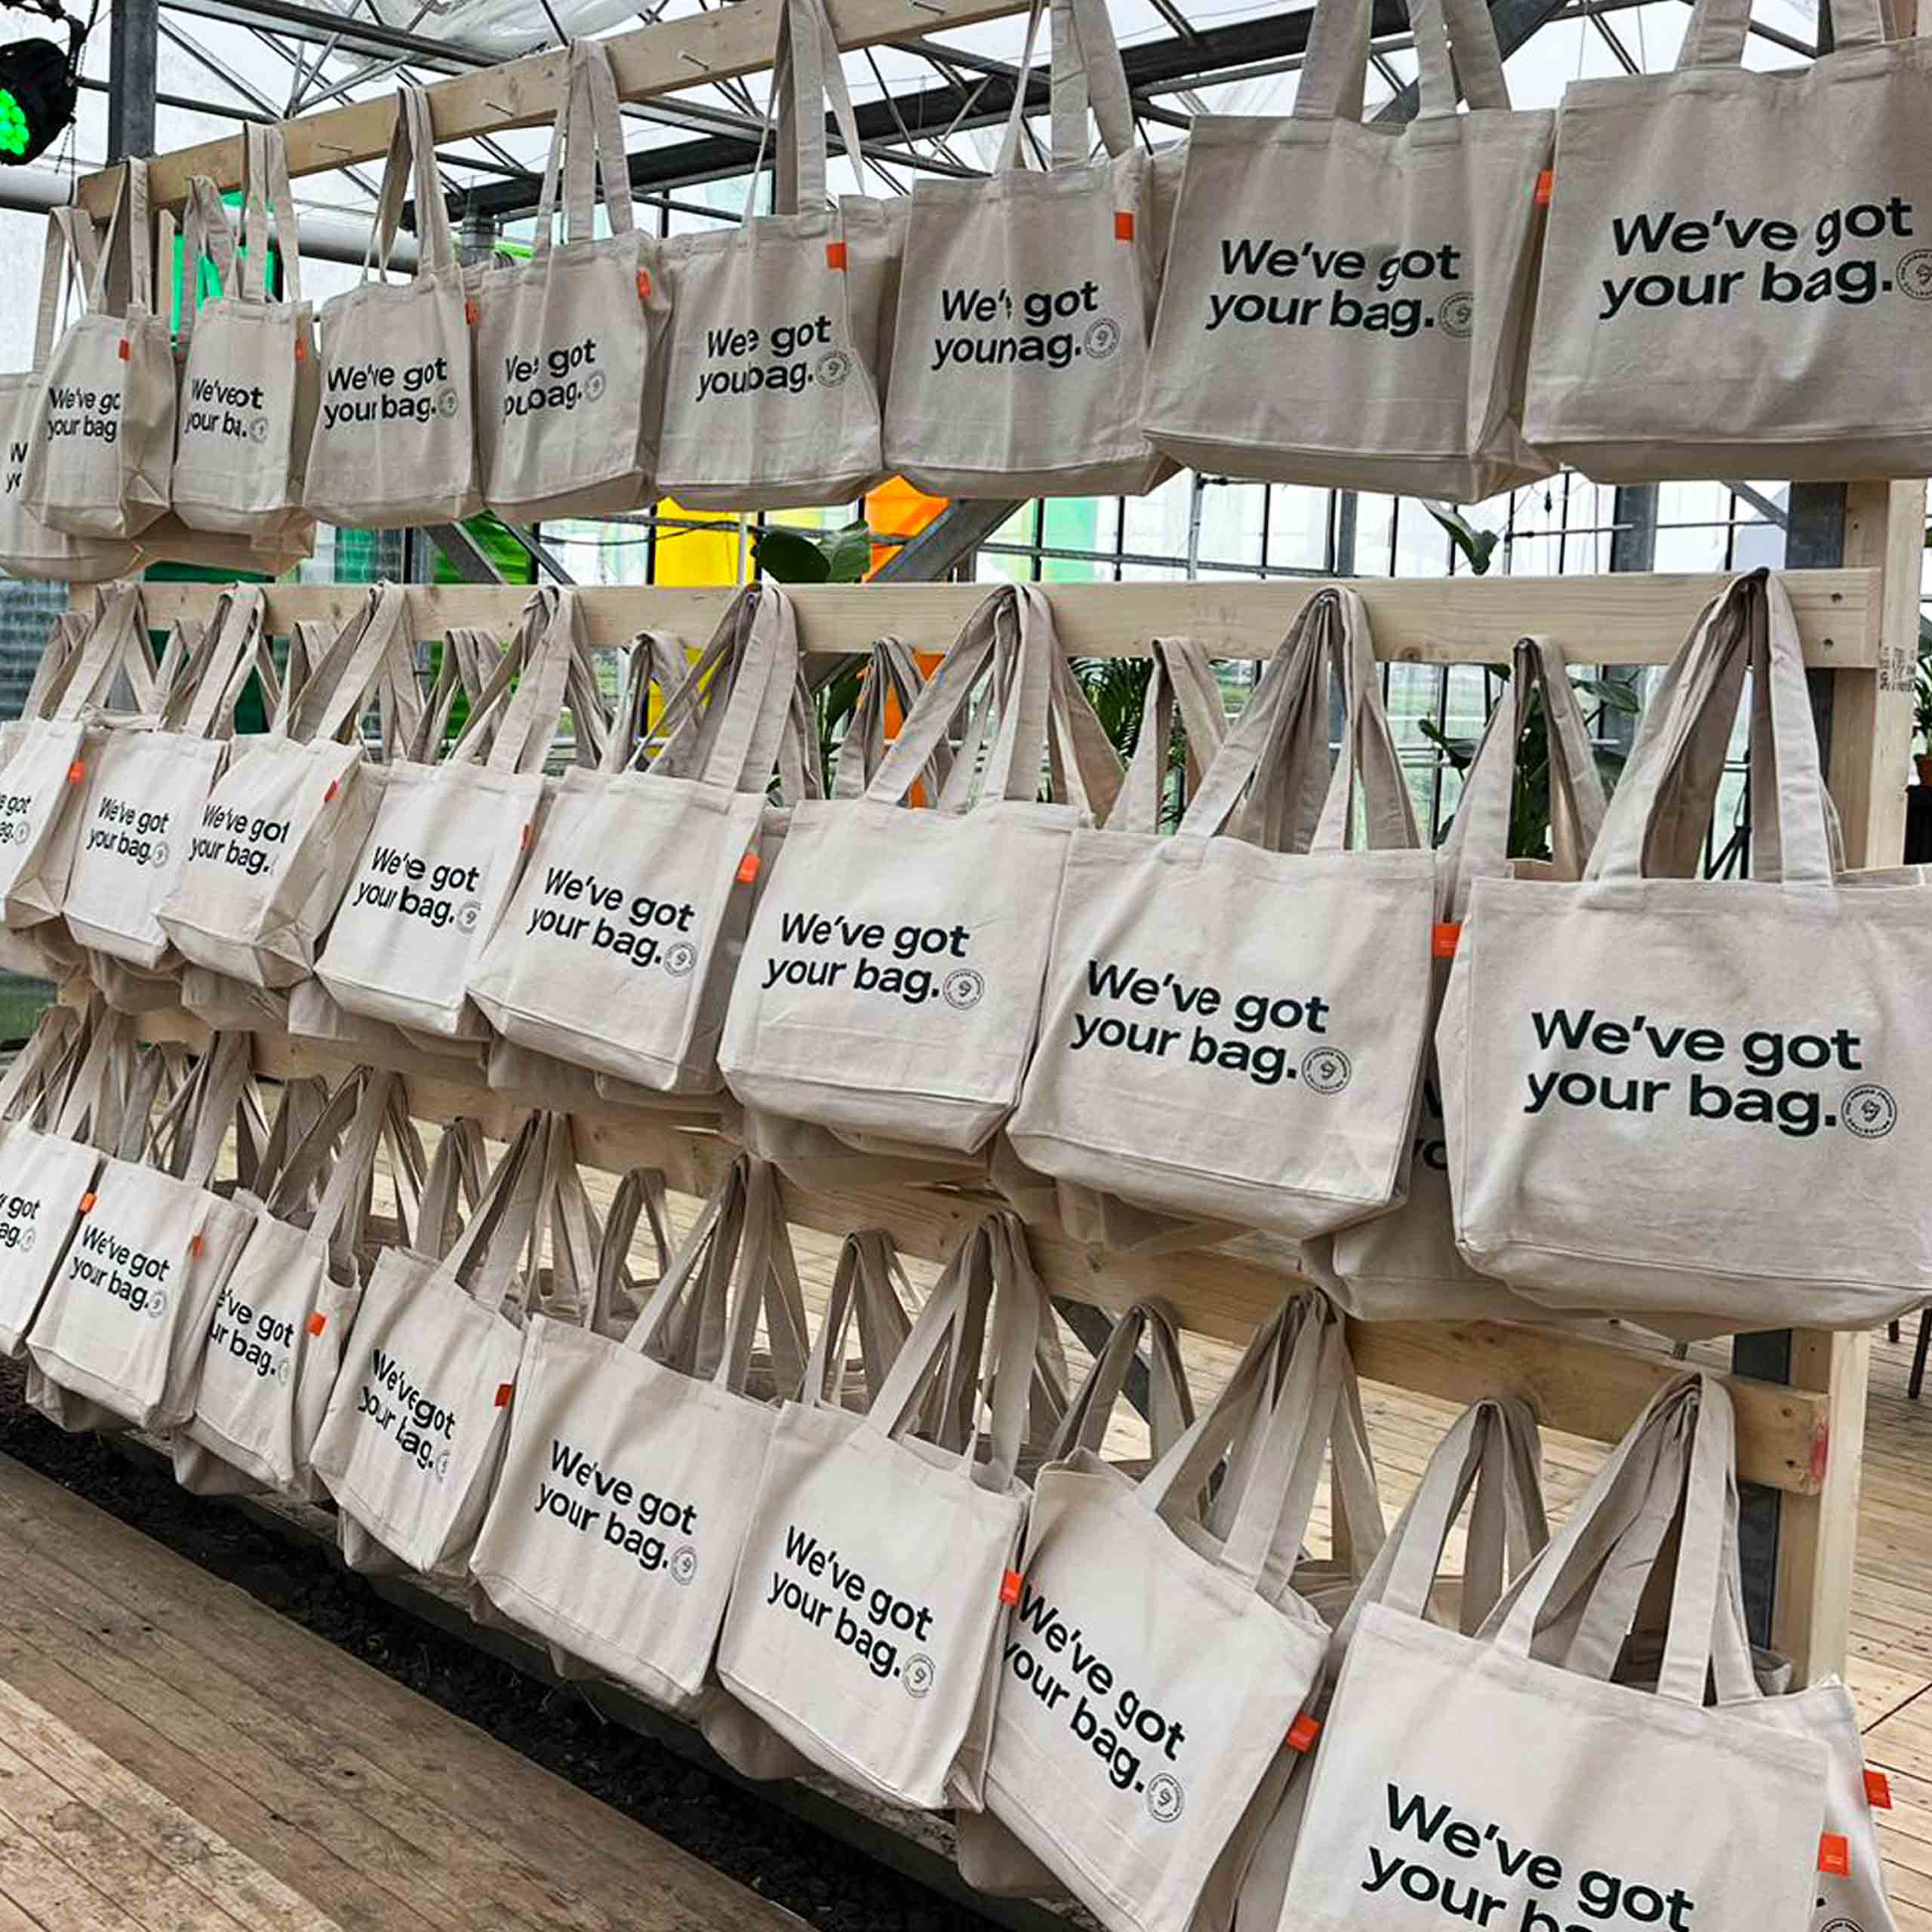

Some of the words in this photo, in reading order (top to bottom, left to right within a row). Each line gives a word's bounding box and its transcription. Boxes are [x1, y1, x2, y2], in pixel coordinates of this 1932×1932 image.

[1613, 210, 1798, 255] We've
[1816, 197, 1913, 257] got
[1221, 239, 1365, 278] We've
[1377, 244, 1461, 291] got
[1598, 271, 1746, 320] your
[1761, 260, 1893, 304] bag.
[1024, 281, 1099, 325] got
[1206, 291, 1321, 331] your
[1329, 289, 1434, 338] bag.
[549, 339, 596, 377] got
[771, 315, 832, 358] got
[404, 357, 448, 392] got
[48, 417, 82, 441] your
[84, 417, 117, 442] bag
[382, 395, 436, 423] bag.
[86, 828, 116, 850] your
[97, 796, 135, 826] We've
[137, 811, 170, 835] got
[202, 804, 248, 835] We've
[189, 836, 224, 861] your
[226, 839, 269, 875] bag.
[432, 865, 479, 893] got
[398, 885, 455, 929] bag.
[543, 866, 623, 912] We've
[629, 896, 695, 931] got
[525, 906, 590, 940] your
[592, 918, 663, 968] bag.
[781, 912, 884, 949] We've
[892, 924, 970, 959] got
[761, 957, 847, 989] your
[854, 958, 940, 1004] bag.
[1088, 960, 1221, 1016] We've
[1233, 994, 1330, 1034] got
[1070, 1013, 1180, 1057] your
[1189, 1026, 1297, 1085] bag.
[1531, 1009, 1724, 1062] We've
[1742, 1029, 1863, 1078] got
[1523, 1071, 1670, 1113] your
[1689, 1075, 1837, 1137] bag.
[8, 1196, 40, 1220] got
[82, 1225, 130, 1265] We've
[130, 1251, 171, 1282] got
[69, 1257, 109, 1286] your
[108, 1270, 149, 1312] bag.
[229, 1334, 275, 1377] bag.
[257, 1313, 294, 1349] got
[413, 1400, 455, 1439] got
[551, 1440, 633, 1505] We've
[638, 1492, 697, 1535] got
[535, 1483, 600, 1532] your
[604, 1512, 668, 1571] bag.
[786, 1524, 865, 1601] We've
[868, 1589, 934, 1641] got
[768, 1571, 832, 1627] your
[834, 1607, 900, 1678] bag.
[1019, 1585, 1113, 1695] We've
[1115, 1690, 1186, 1761] got
[1070, 1697, 1144, 1792] bag.
[1386, 1783, 1562, 1890] We've
[1577, 1869, 1694, 1932] got
[1361, 1845, 1507, 1927] your
